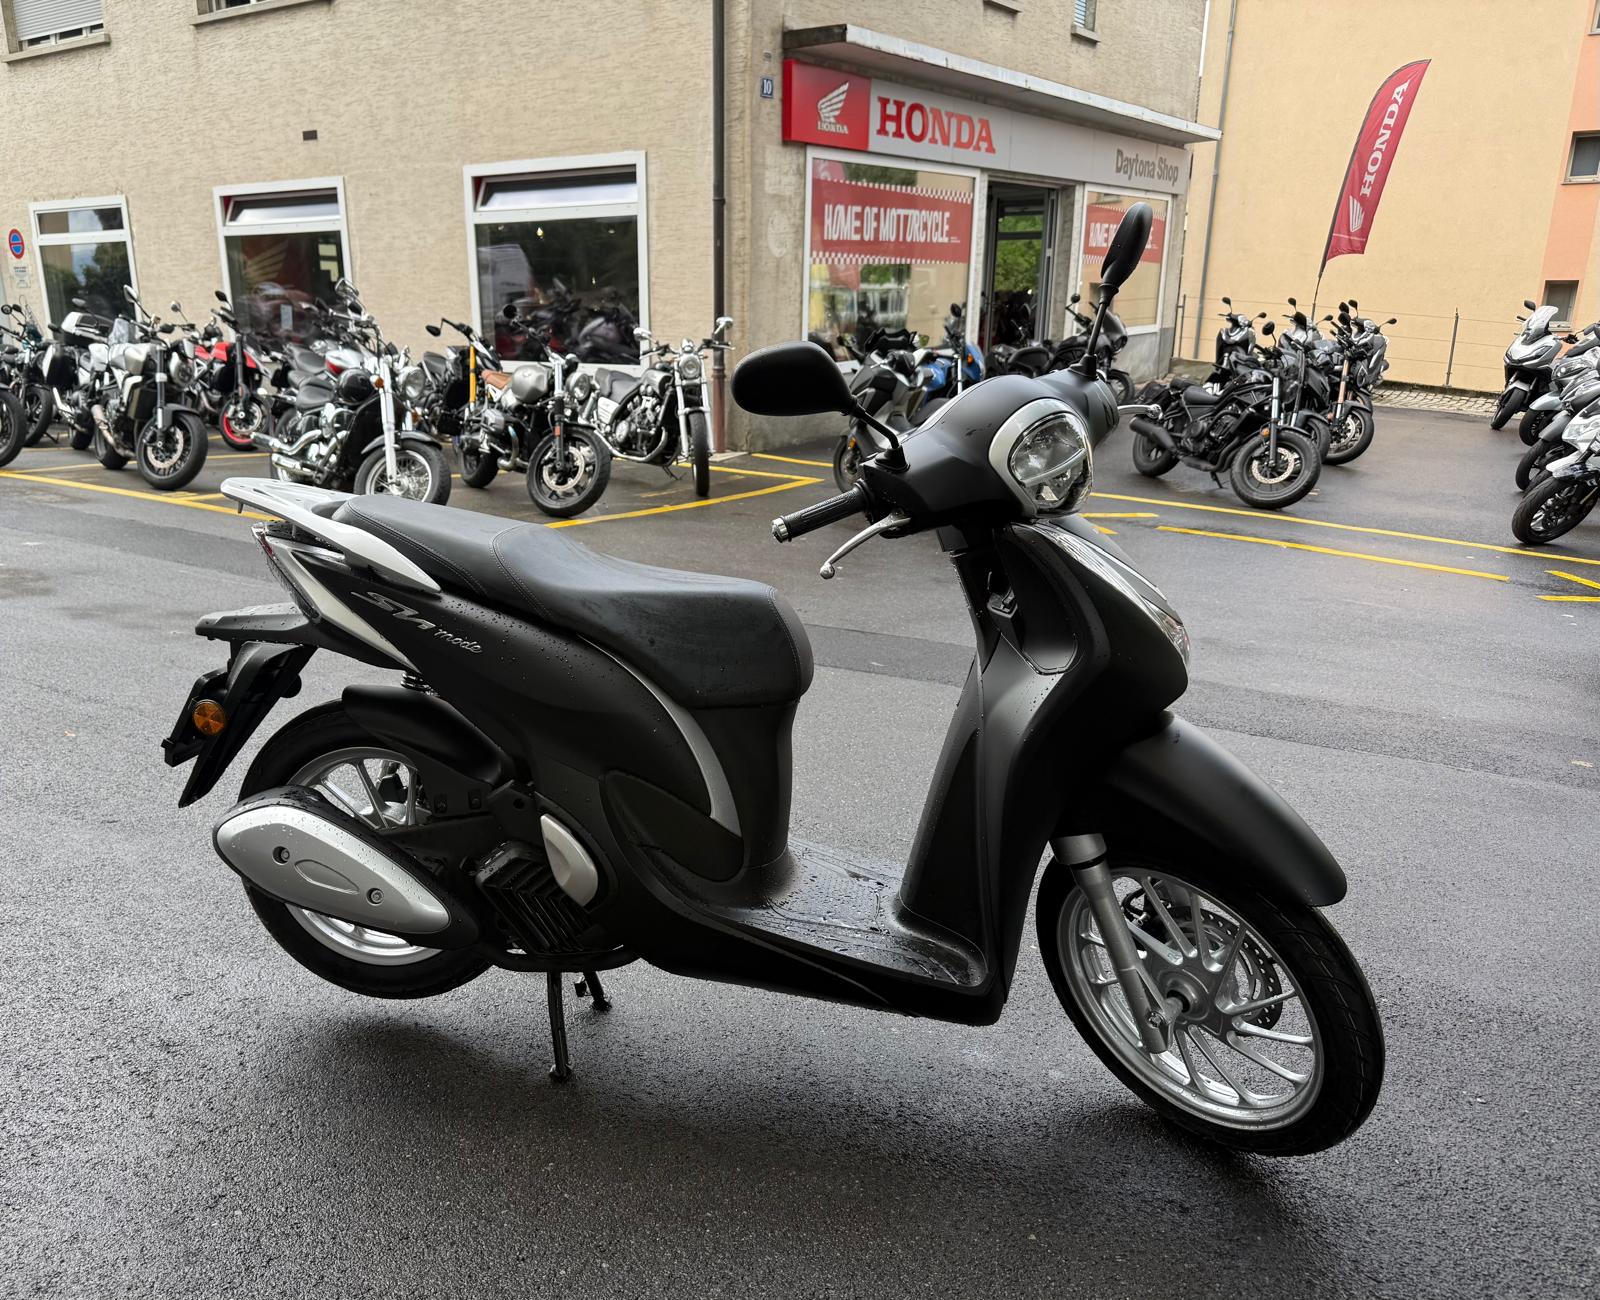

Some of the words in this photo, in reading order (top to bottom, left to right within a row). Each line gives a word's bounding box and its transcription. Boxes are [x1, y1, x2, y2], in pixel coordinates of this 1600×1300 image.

[763, 79, 772, 95] 10
[817, 121, 848, 134] HONDA
[876, 95, 996, 155] HONDA
[1360, 79, 1411, 198] HONDA
[1115, 147, 1156, 181] Daytona
[1156, 156, 1179, 187] Shop
[863, 206, 879, 242] OF
[433, 628, 483, 654] mode
